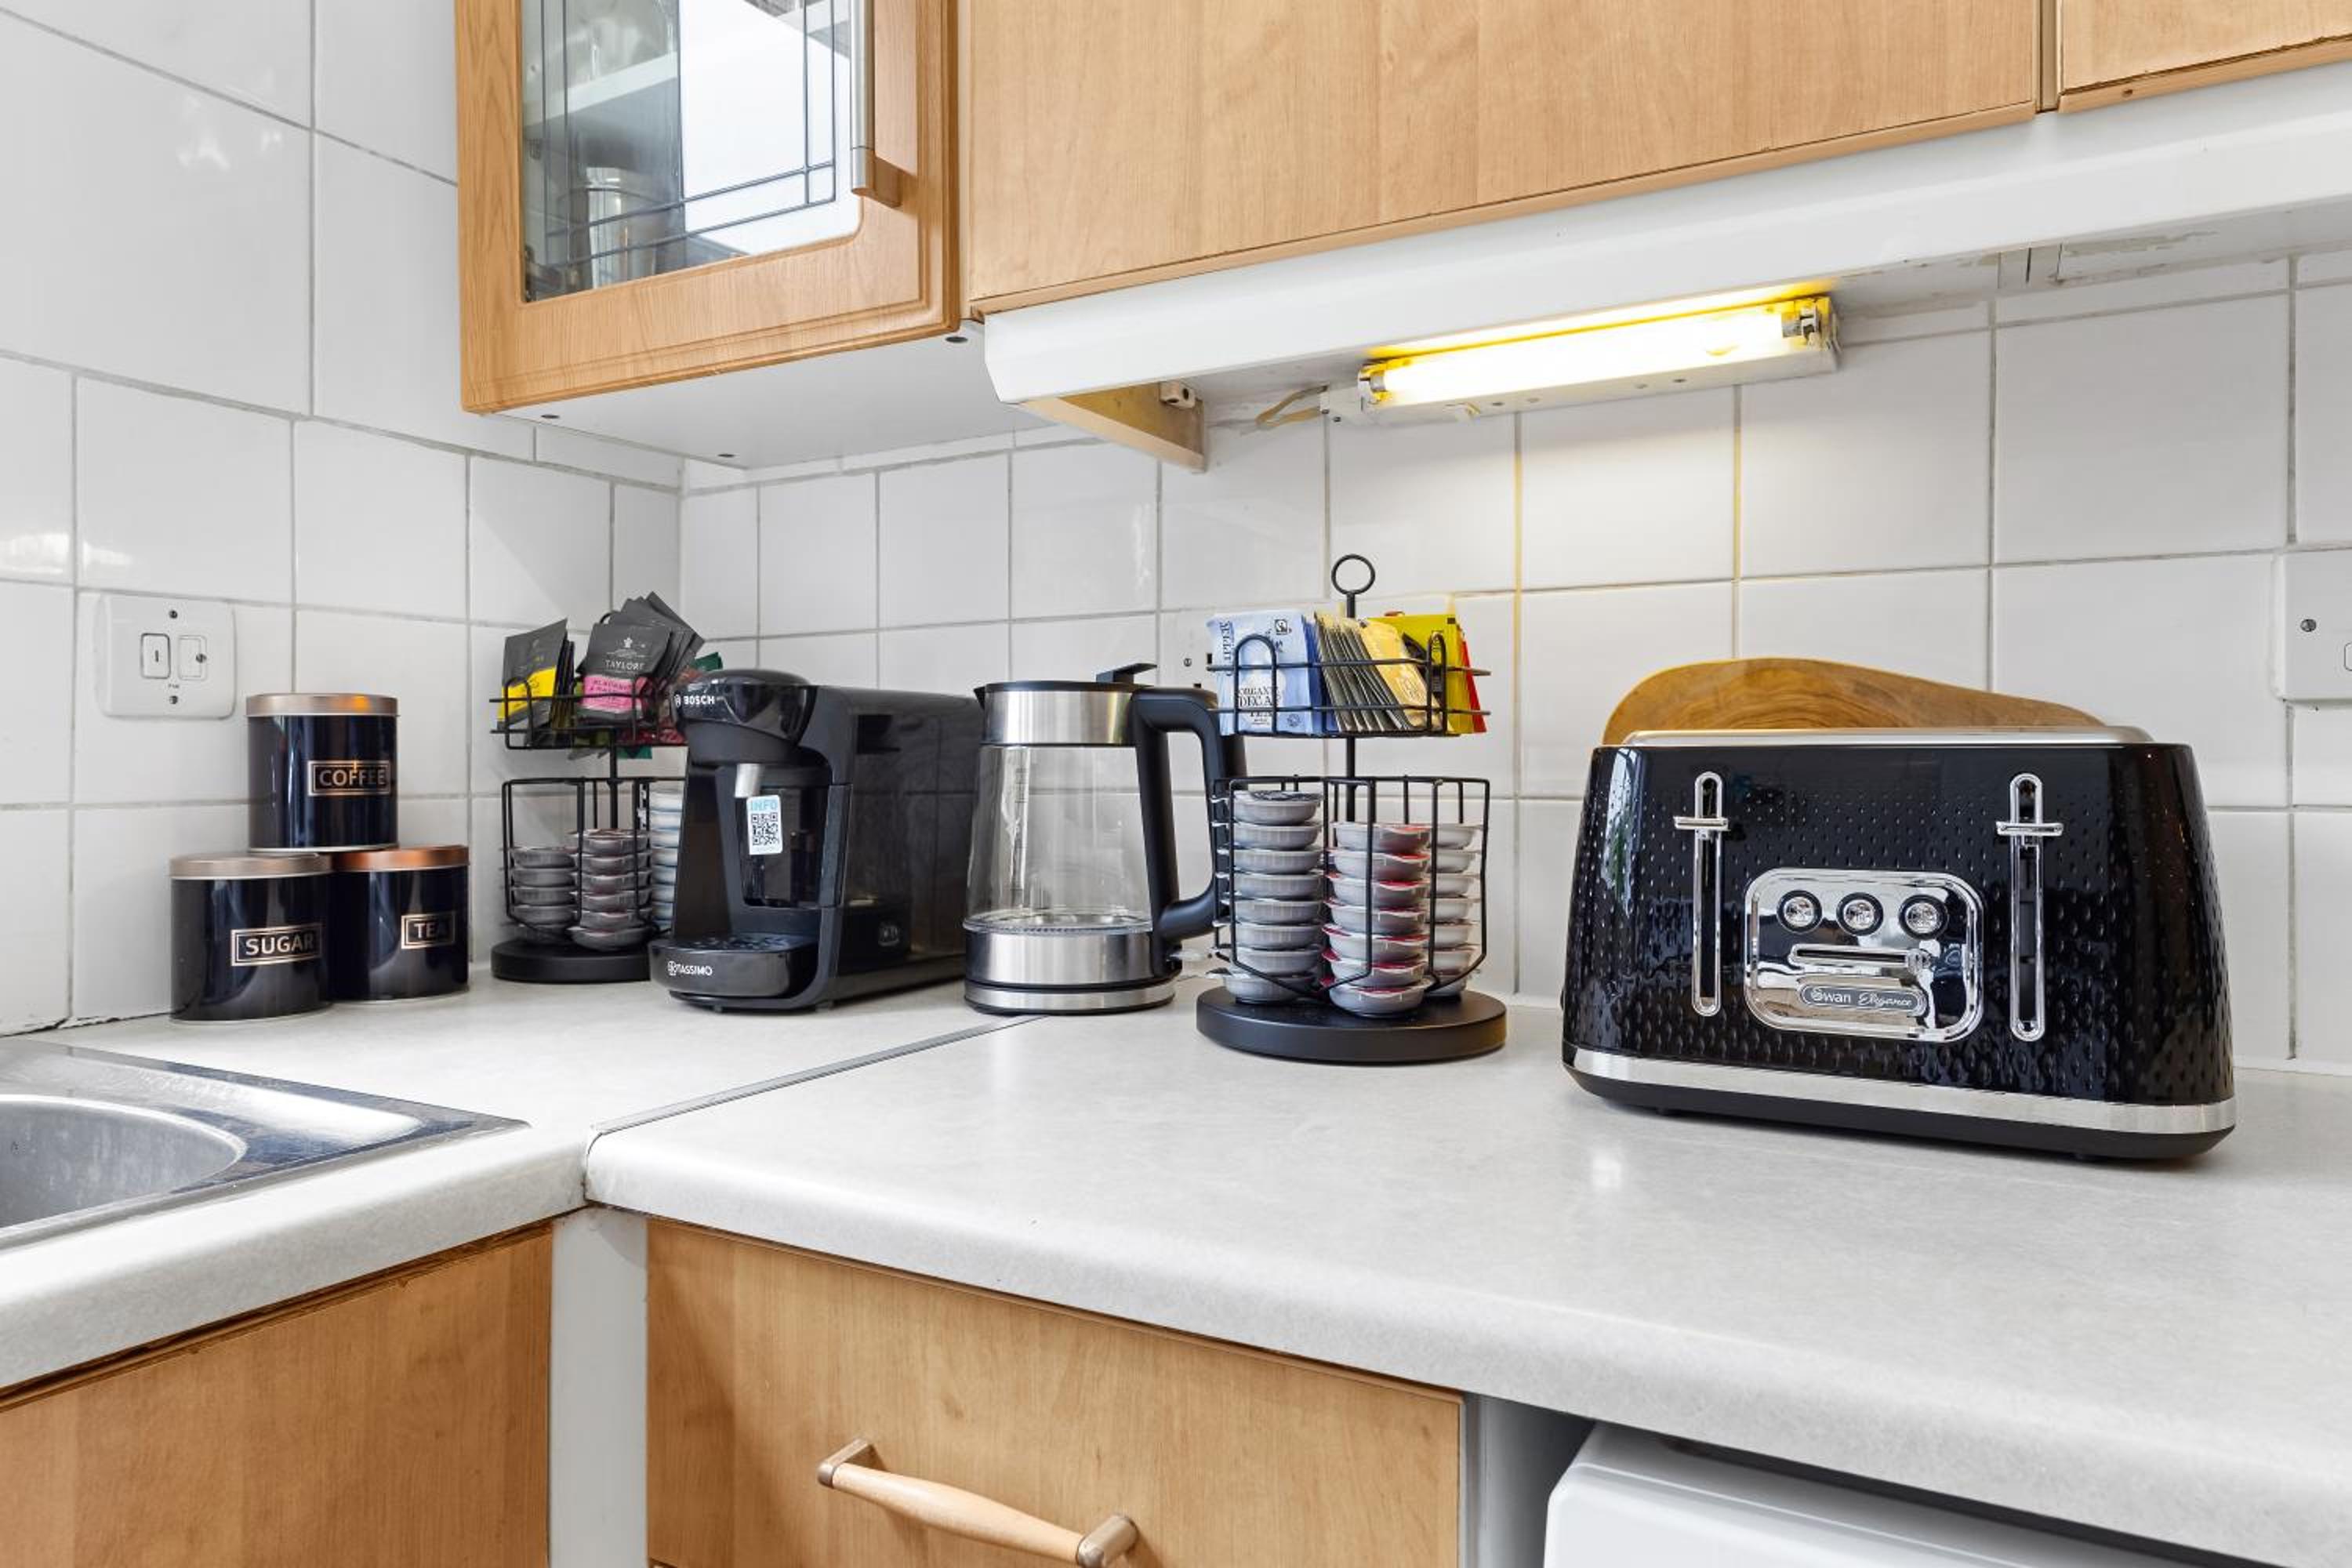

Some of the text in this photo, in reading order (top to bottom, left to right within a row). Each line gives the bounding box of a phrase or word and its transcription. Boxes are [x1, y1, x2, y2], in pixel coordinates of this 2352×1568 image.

[683, 695, 715, 705] BOSCH
[319, 769, 386, 786] COFFEE
[751, 800, 778, 811] INFO
[245, 932, 315, 956] SUGAR
[675, 964, 713, 976] TASSIMO
[1810, 987, 1851, 1004] Swan
